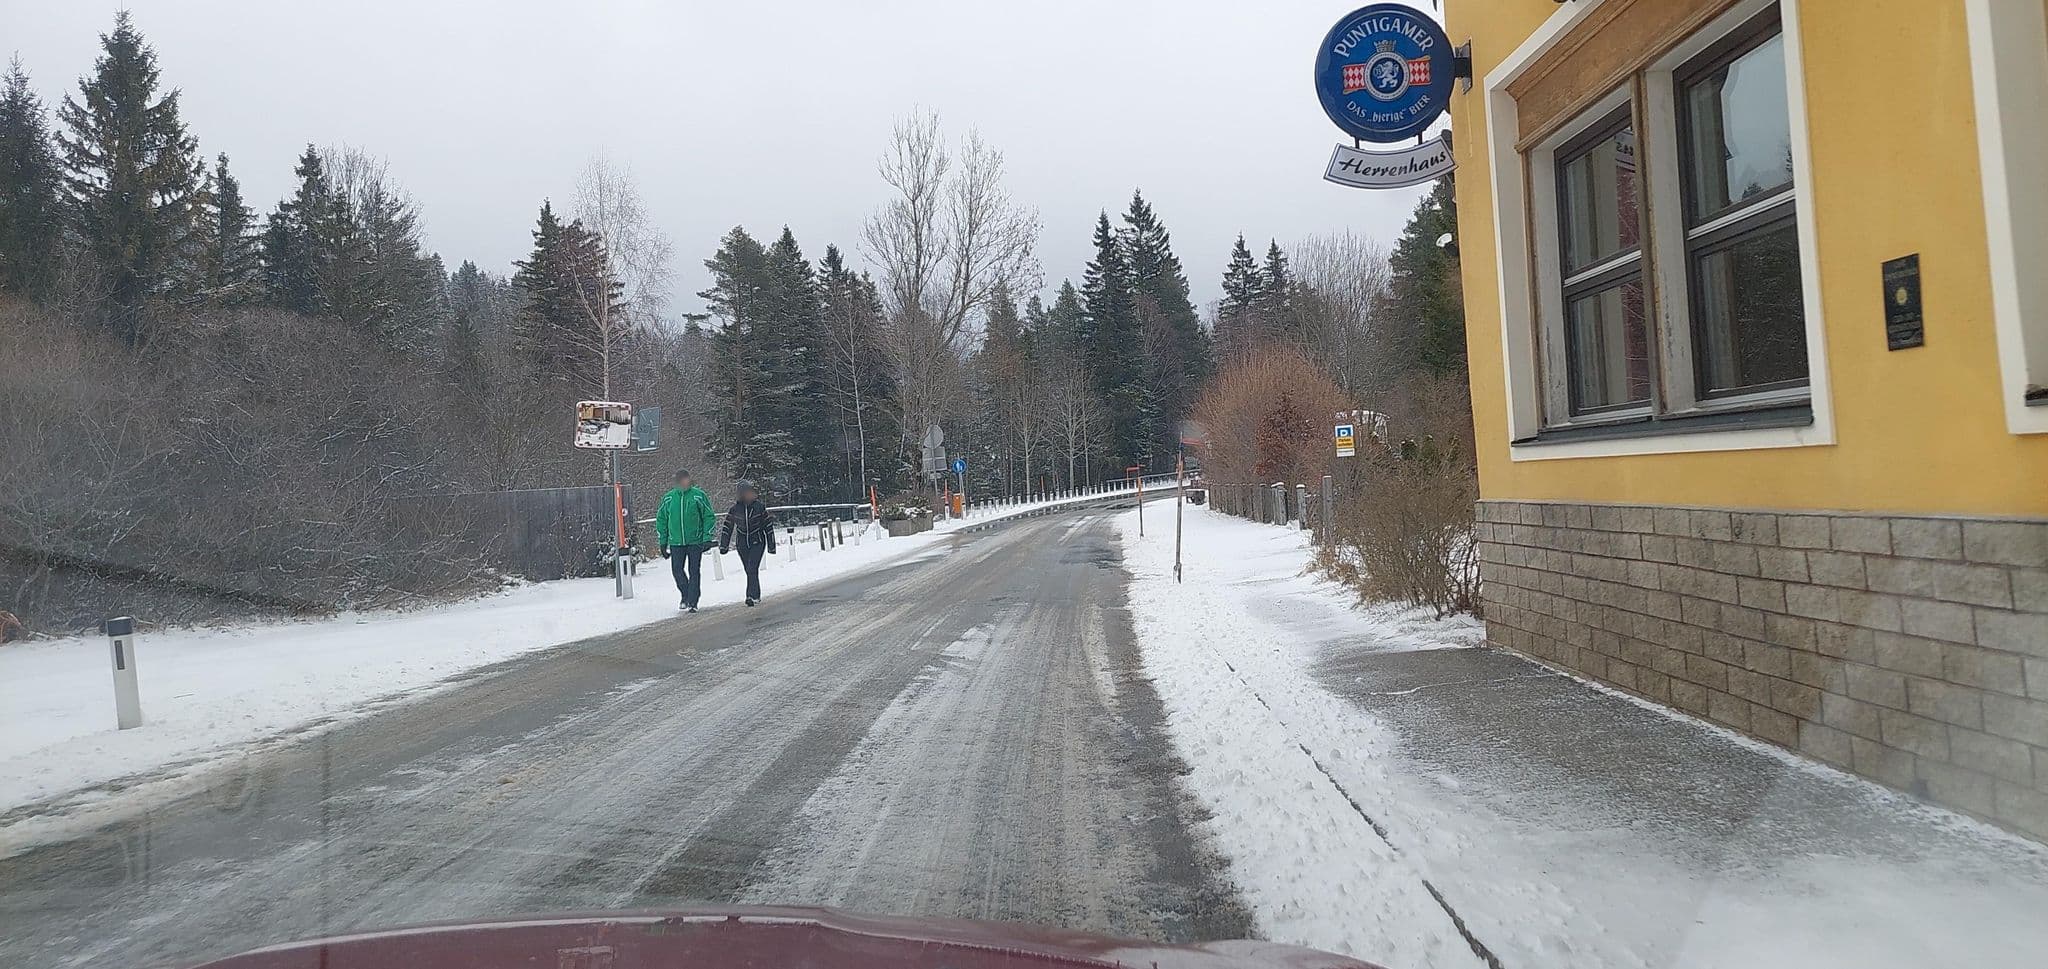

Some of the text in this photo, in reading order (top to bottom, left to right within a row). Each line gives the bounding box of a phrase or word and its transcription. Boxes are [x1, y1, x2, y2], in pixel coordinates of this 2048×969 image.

[1334, 16, 1434, 57] PUNTIGAMER
[1346, 100, 1367, 118] DAS
[1408, 94, 1431, 115] BIER
[1338, 151, 1446, 177] Herrenhaus
